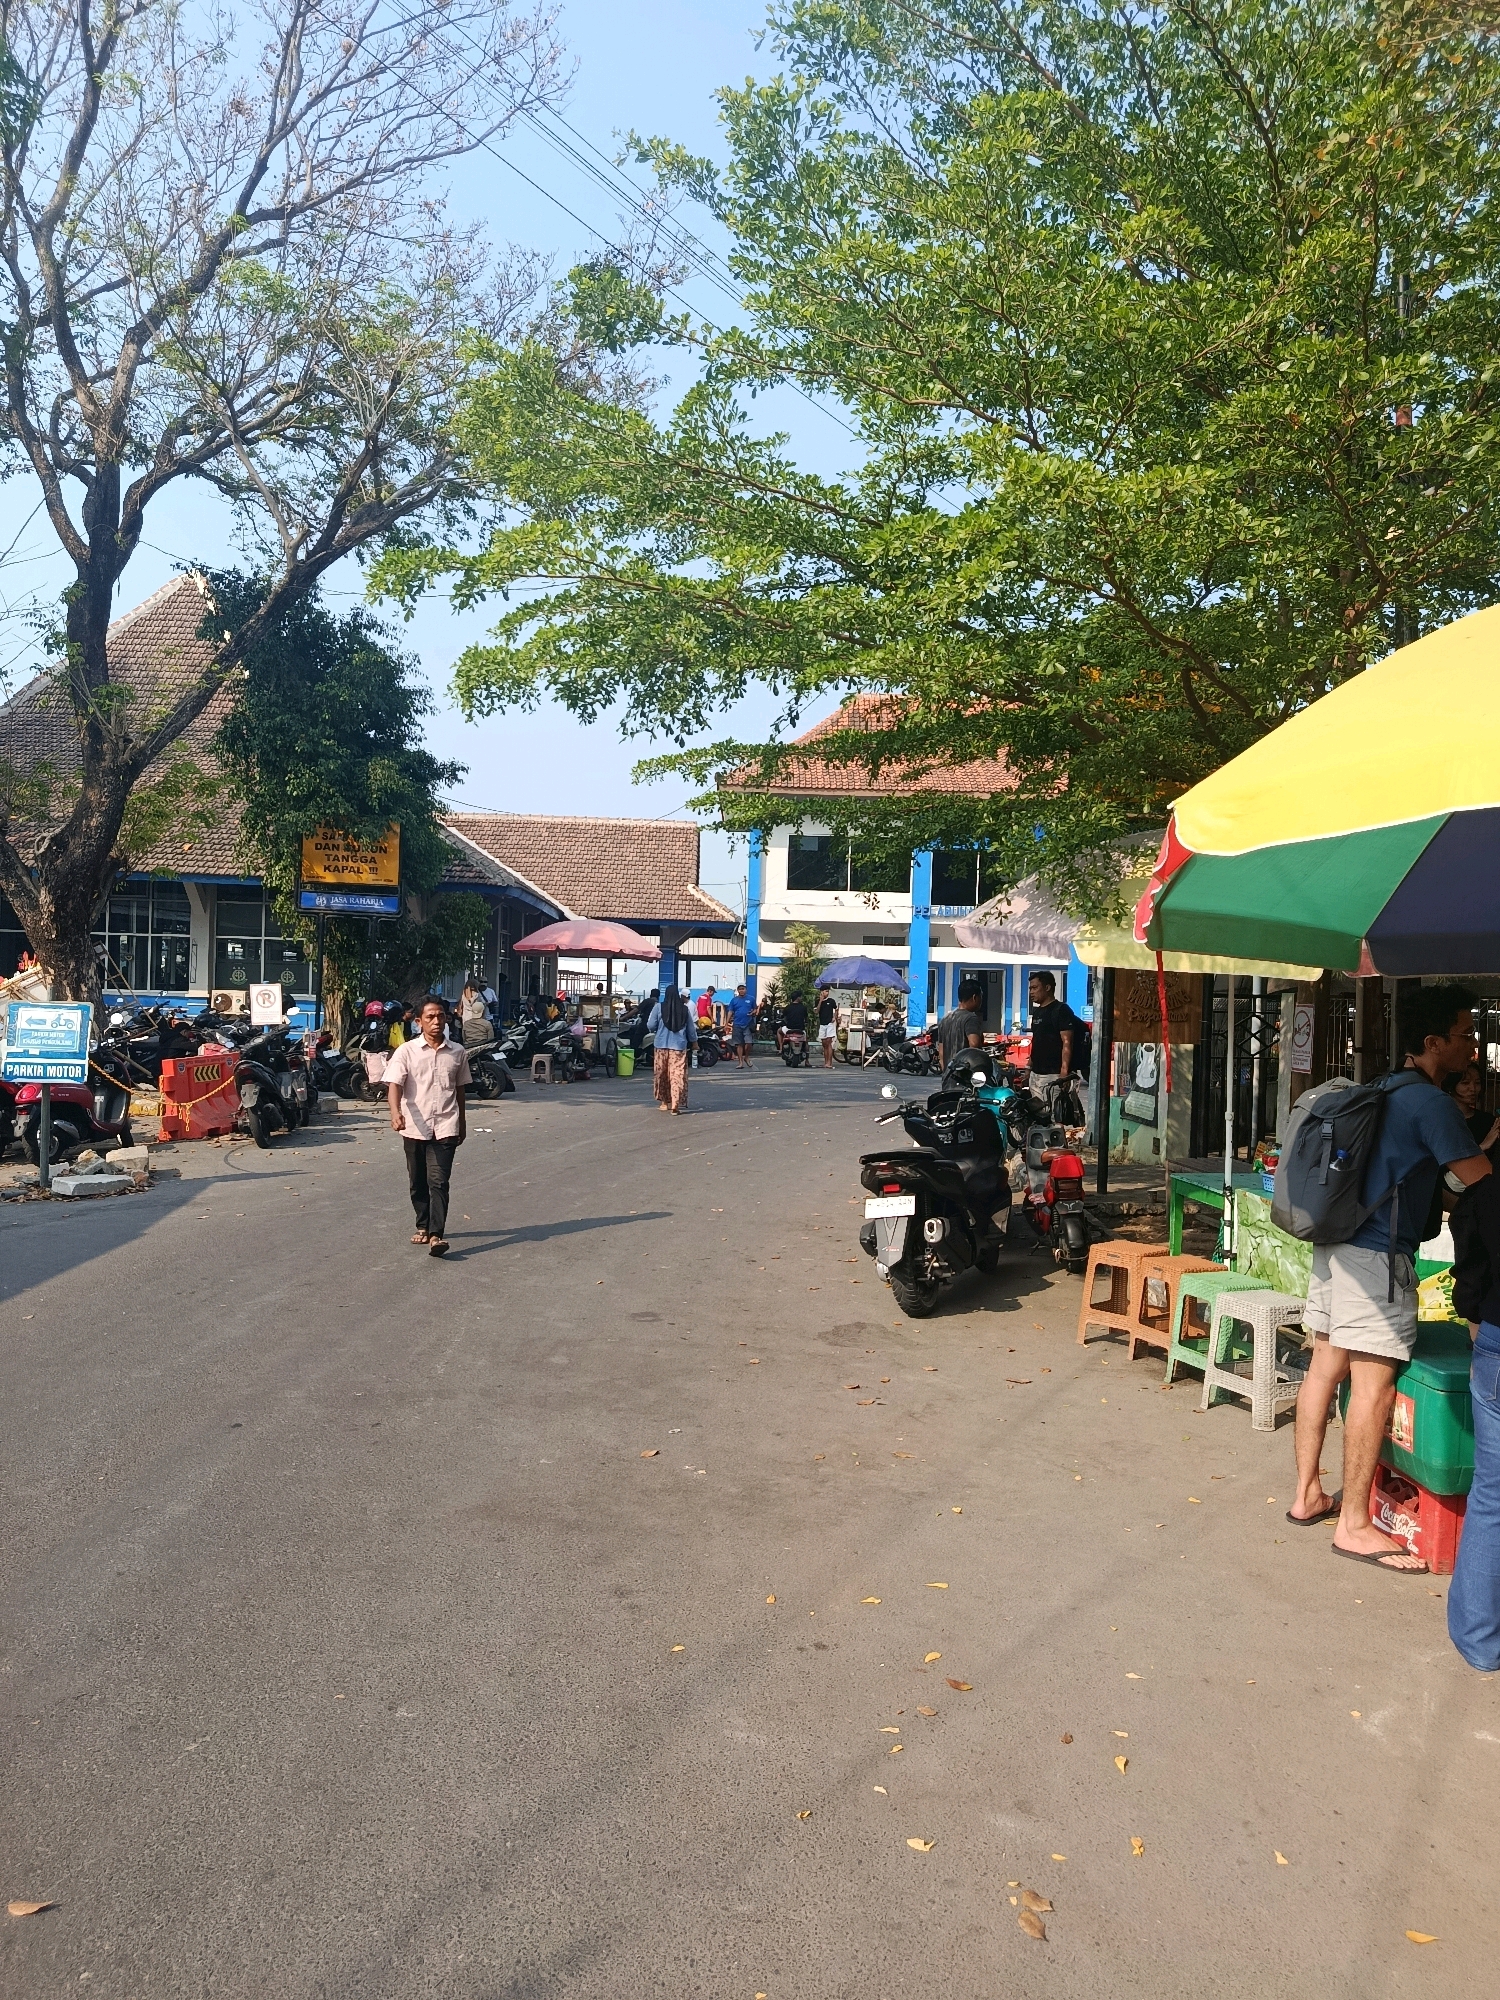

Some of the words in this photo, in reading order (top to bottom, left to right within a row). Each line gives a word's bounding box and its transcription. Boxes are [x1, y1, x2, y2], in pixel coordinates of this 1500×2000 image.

[314, 842, 340, 852] DAN
[343, 842, 387, 855] URUN
[325, 853, 377, 865] TANGGA
[323, 864, 363, 875] KAPAL
[330, 896, 347, 904] JASA
[349, 897, 384, 906] RAHARJA
[6, 1064, 44, 1077] PARKIR
[46, 1065, 82, 1078] MOTOR
